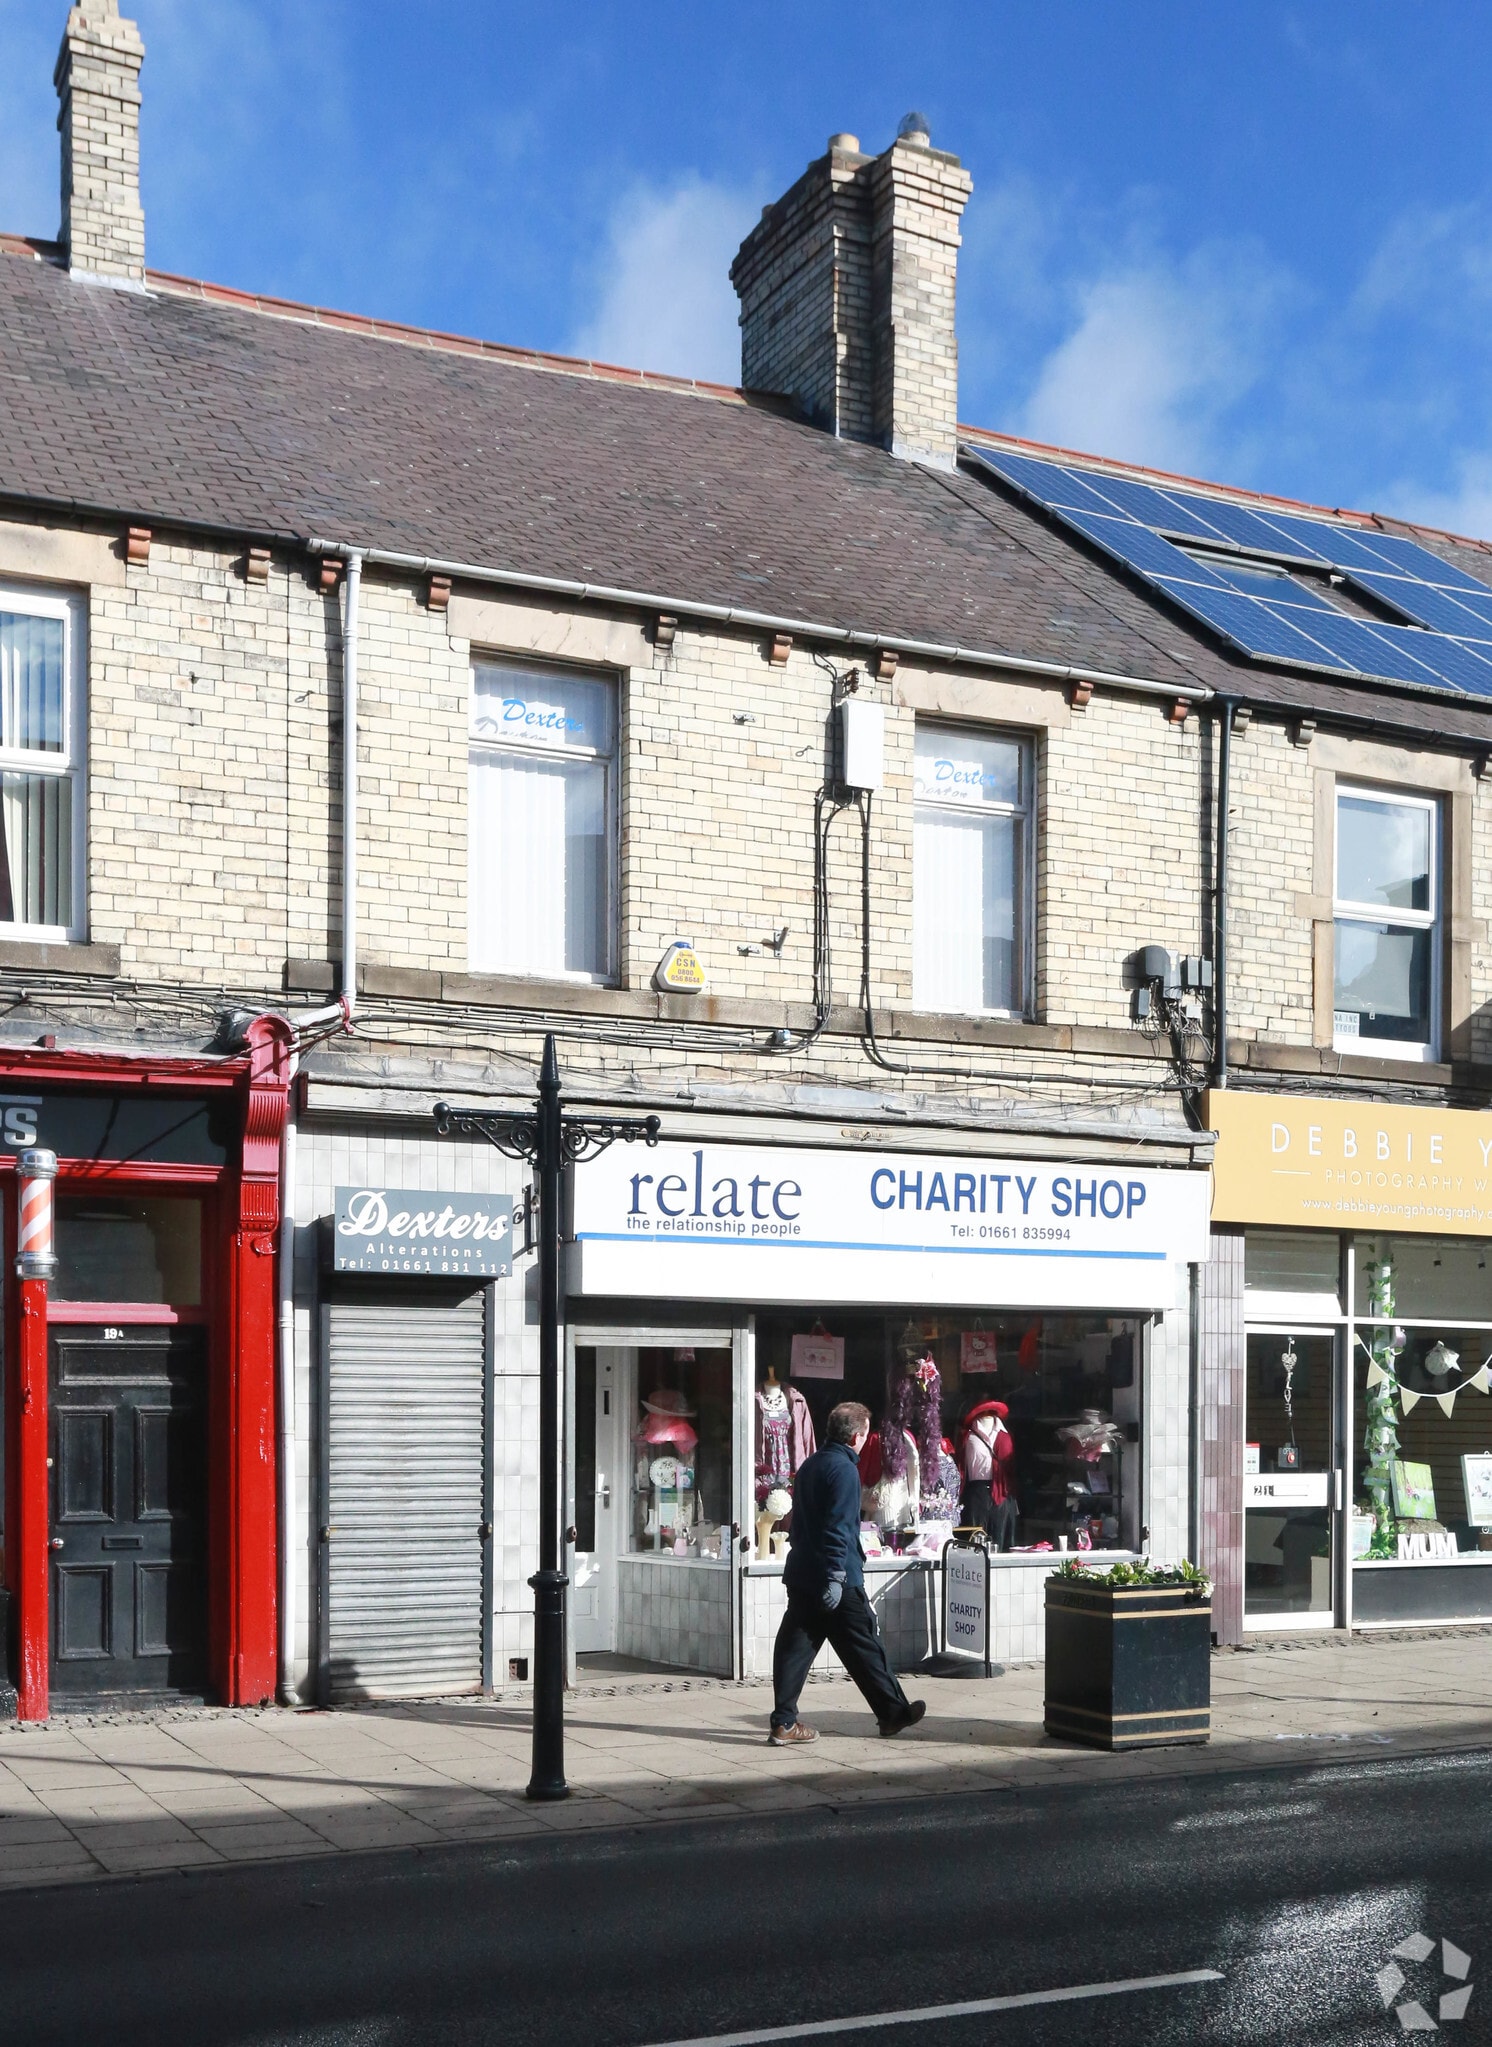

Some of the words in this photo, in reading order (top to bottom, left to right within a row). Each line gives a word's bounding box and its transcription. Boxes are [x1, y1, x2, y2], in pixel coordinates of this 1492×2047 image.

[676, 958, 696, 967] CSN
[0, 1107, 38, 1146] S
[1271, 1122, 1444, 1165] DEBBIE
[627, 1150, 802, 1221] relate
[870, 1168, 1037, 1214] CHARITY
[1051, 1177, 1147, 1219] SHOP
[1325, 1169, 1464, 1192] PHOTOGRAPHY
[338, 1190, 509, 1241] Dexters
[627, 1217, 650, 1230] the
[656, 1218, 746, 1236] relationship
[751, 1222, 801, 1237] people
[950, 1225, 974, 1238] Tel:
[979, 1226, 1017, 1239] 01661
[1022, 1227, 1071, 1241] 835994
[366, 1243, 483, 1258] Alterations
[339, 1258, 372, 1269] Tel:
[382, 1259, 431, 1272] 01661
[441, 1262, 470, 1273] 831
[480, 1263, 507, 1274] 112
[1398, 1532, 1458, 1560] MUM
[950, 1564, 982, 1582] relate
[949, 1602, 982, 1619] CHARITY
[955, 1621, 976, 1635] SHOP
